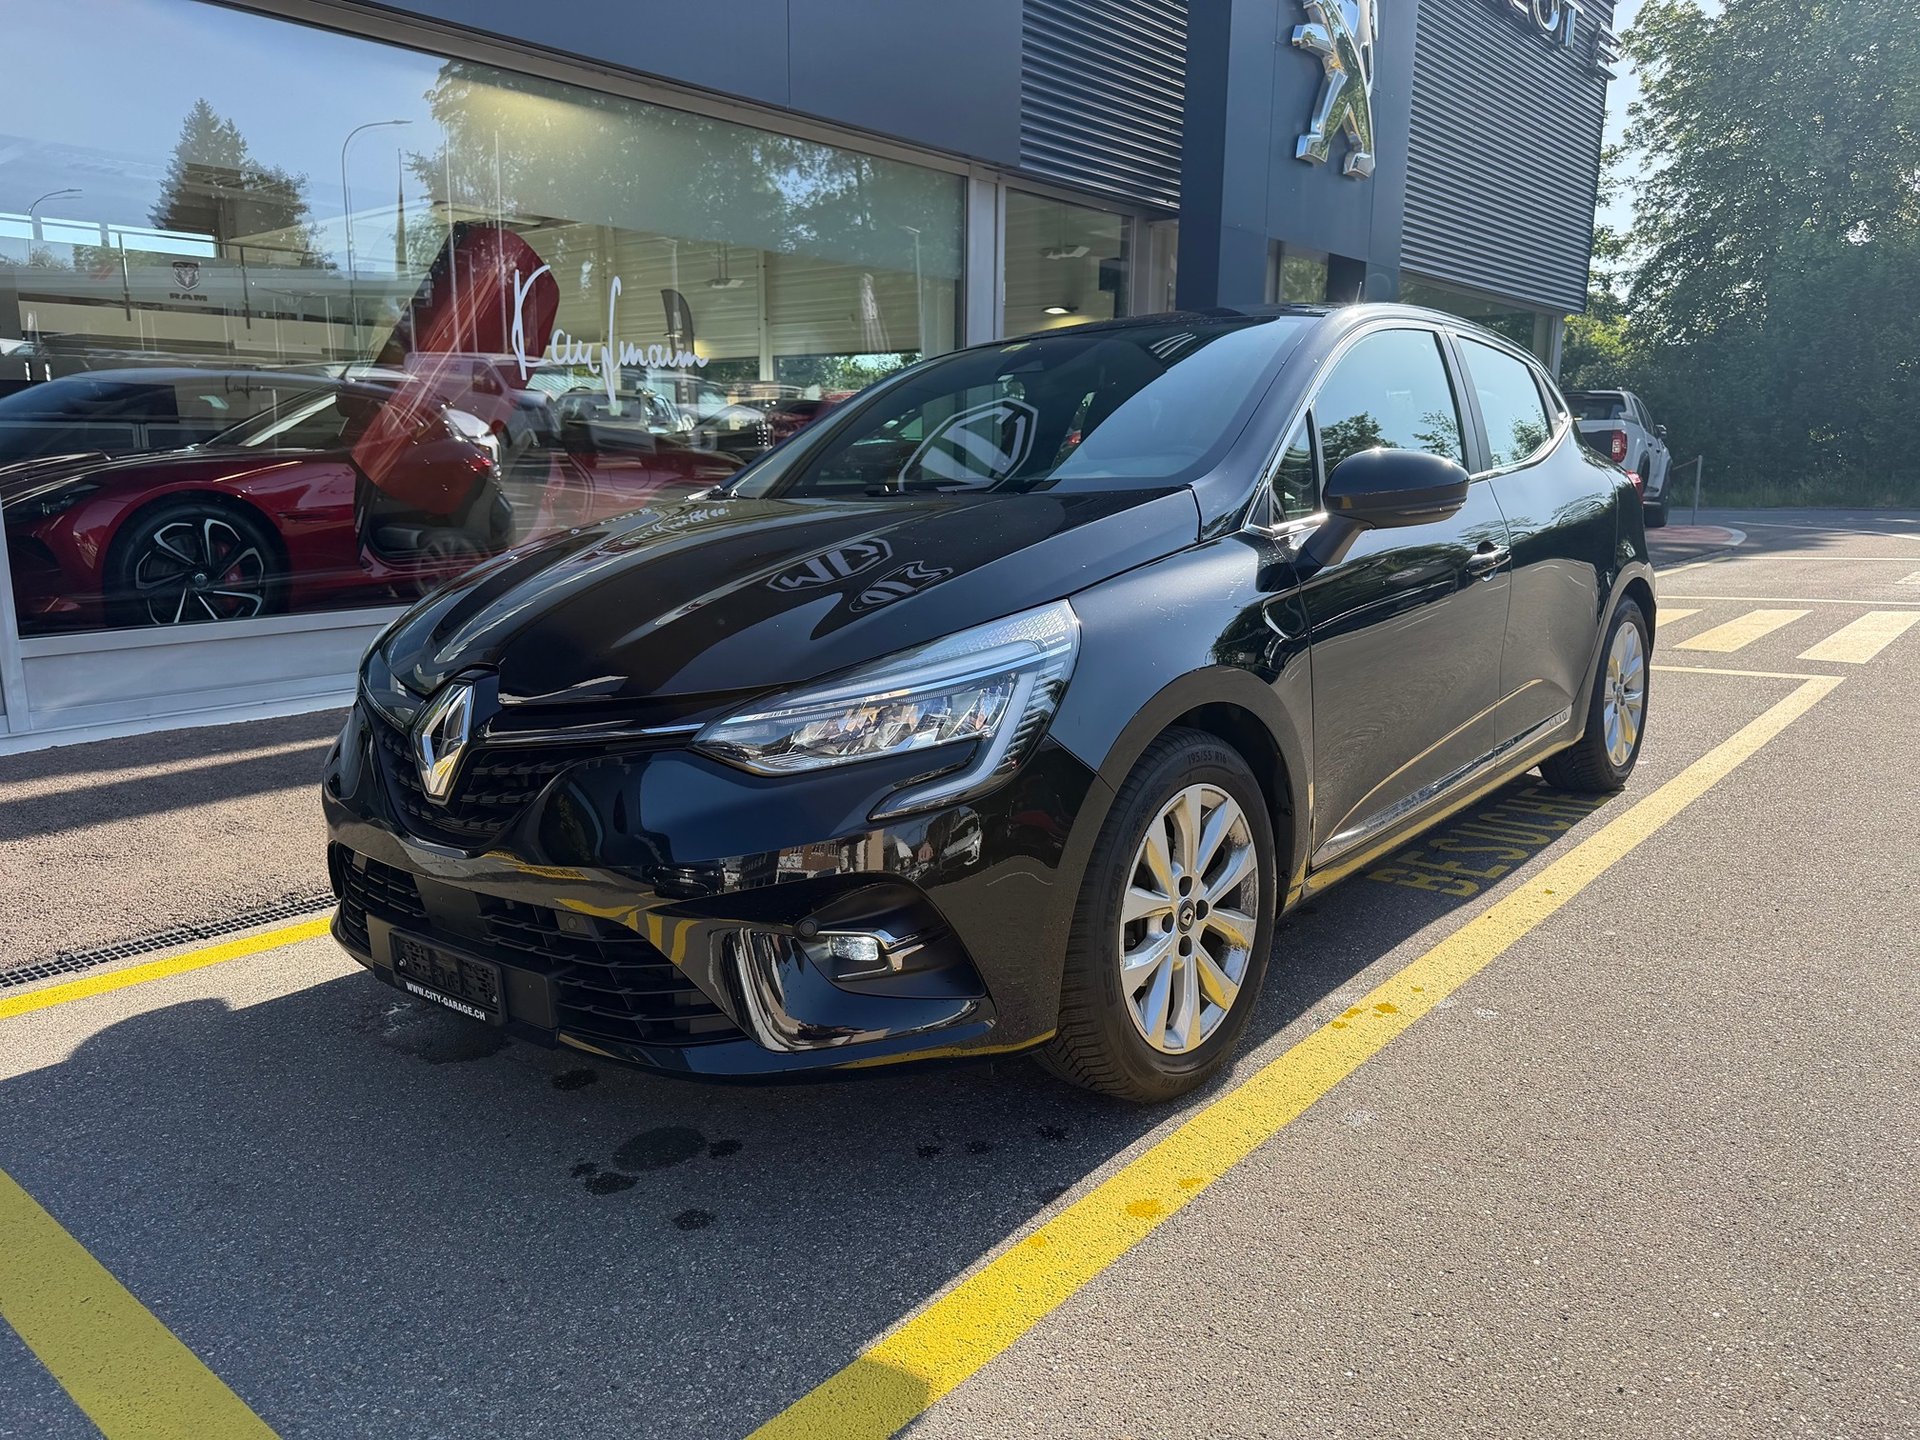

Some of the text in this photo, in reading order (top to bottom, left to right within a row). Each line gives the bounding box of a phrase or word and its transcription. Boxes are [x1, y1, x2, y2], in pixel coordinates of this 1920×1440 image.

[169, 292, 208, 302] RAM
[1548, 711, 1568, 726] CLIO
[405, 981, 486, 1021] WWW.CITY-GARAGE.CH
